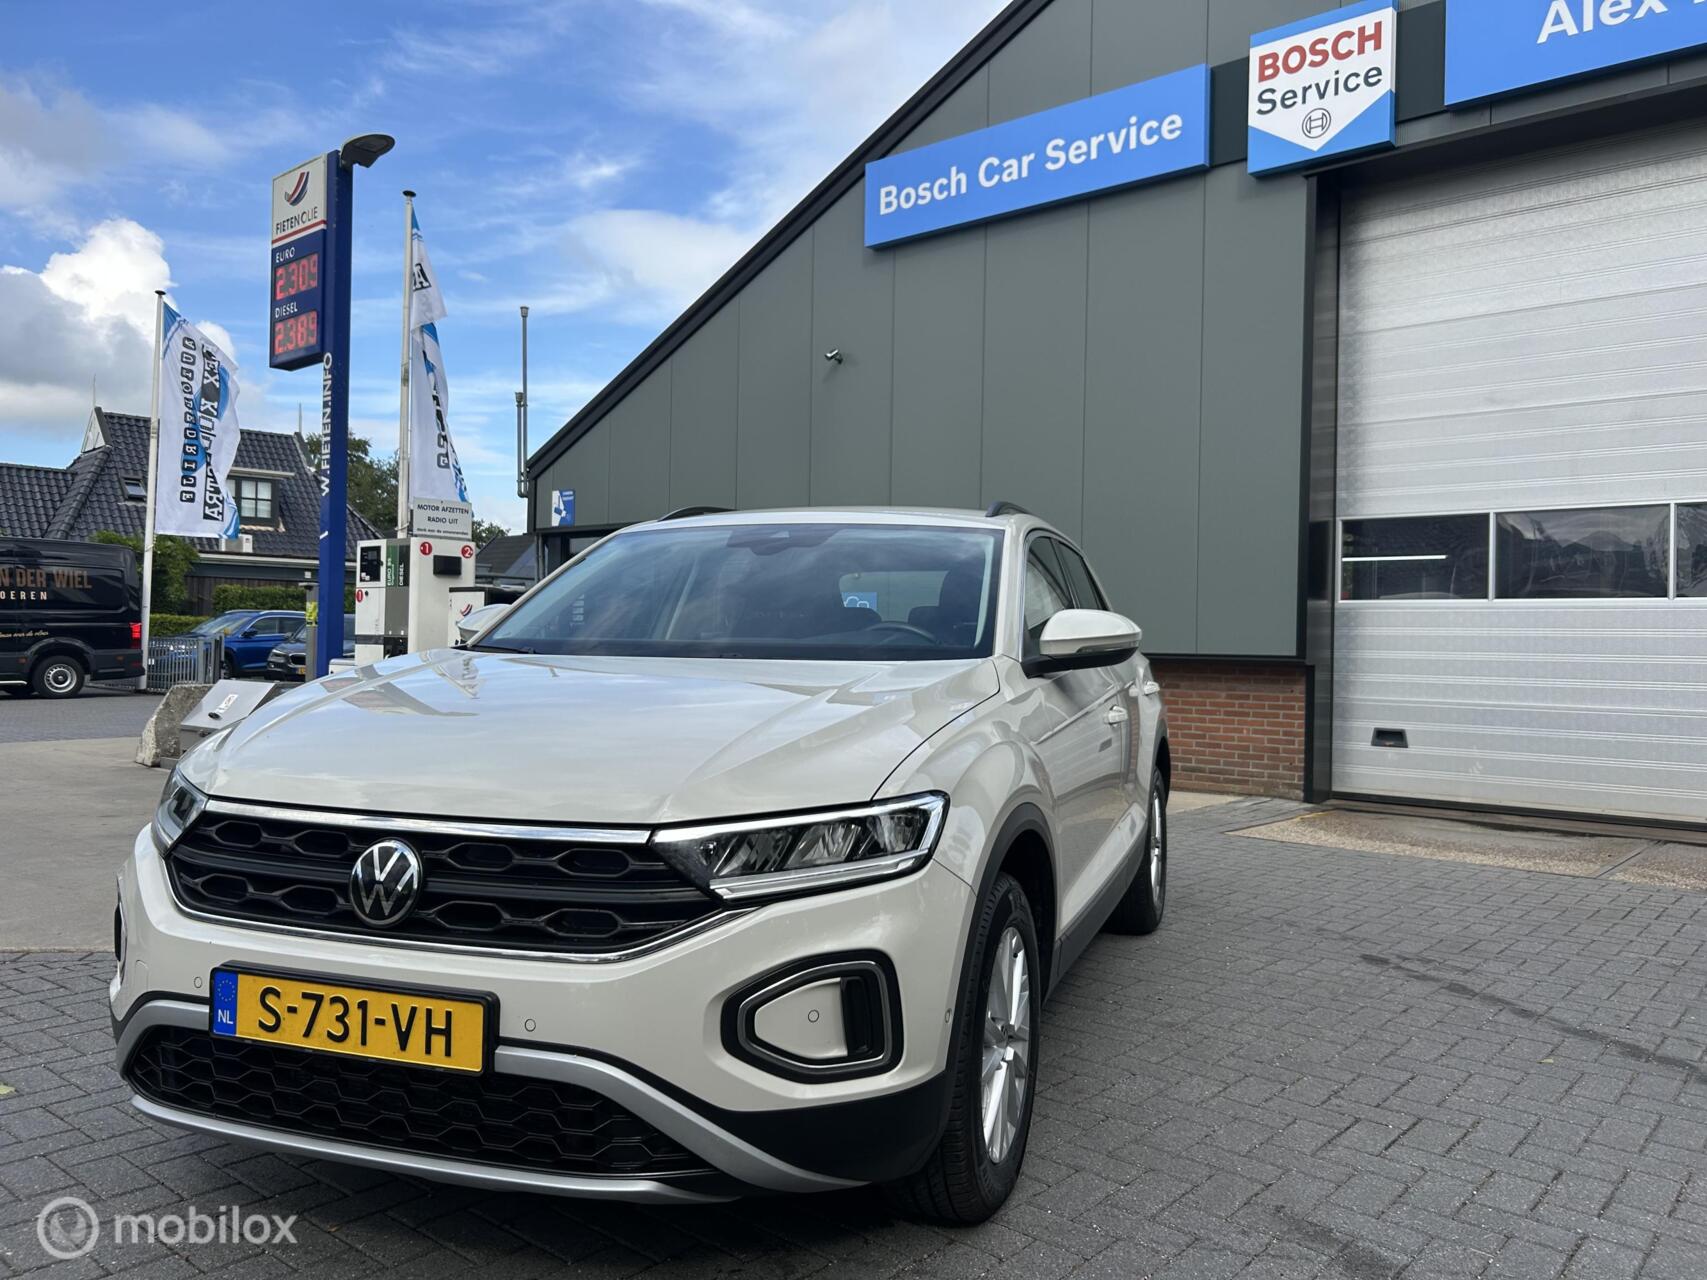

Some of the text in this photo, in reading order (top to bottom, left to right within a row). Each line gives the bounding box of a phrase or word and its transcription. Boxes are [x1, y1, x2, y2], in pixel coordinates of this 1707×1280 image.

[1258, 20, 1382, 83] BOSCH
[1256, 66, 1383, 115] Service
[879, 113, 1183, 215] Bosch Car Service
[276, 247, 295, 262] EURO
[276, 254, 318, 300] 2.309
[275, 302, 298, 318] DIESEL
[275, 310, 318, 355] 2.389
[417, 504, 469, 515] MOTOR AFZETTEN
[428, 516, 446, 524] RADIO
[16, 568, 46, 587] DER
[53, 568, 92, 588] WIEL
[217, 1009, 234, 1024] NL
[258, 986, 453, 1057] S-731-VH
